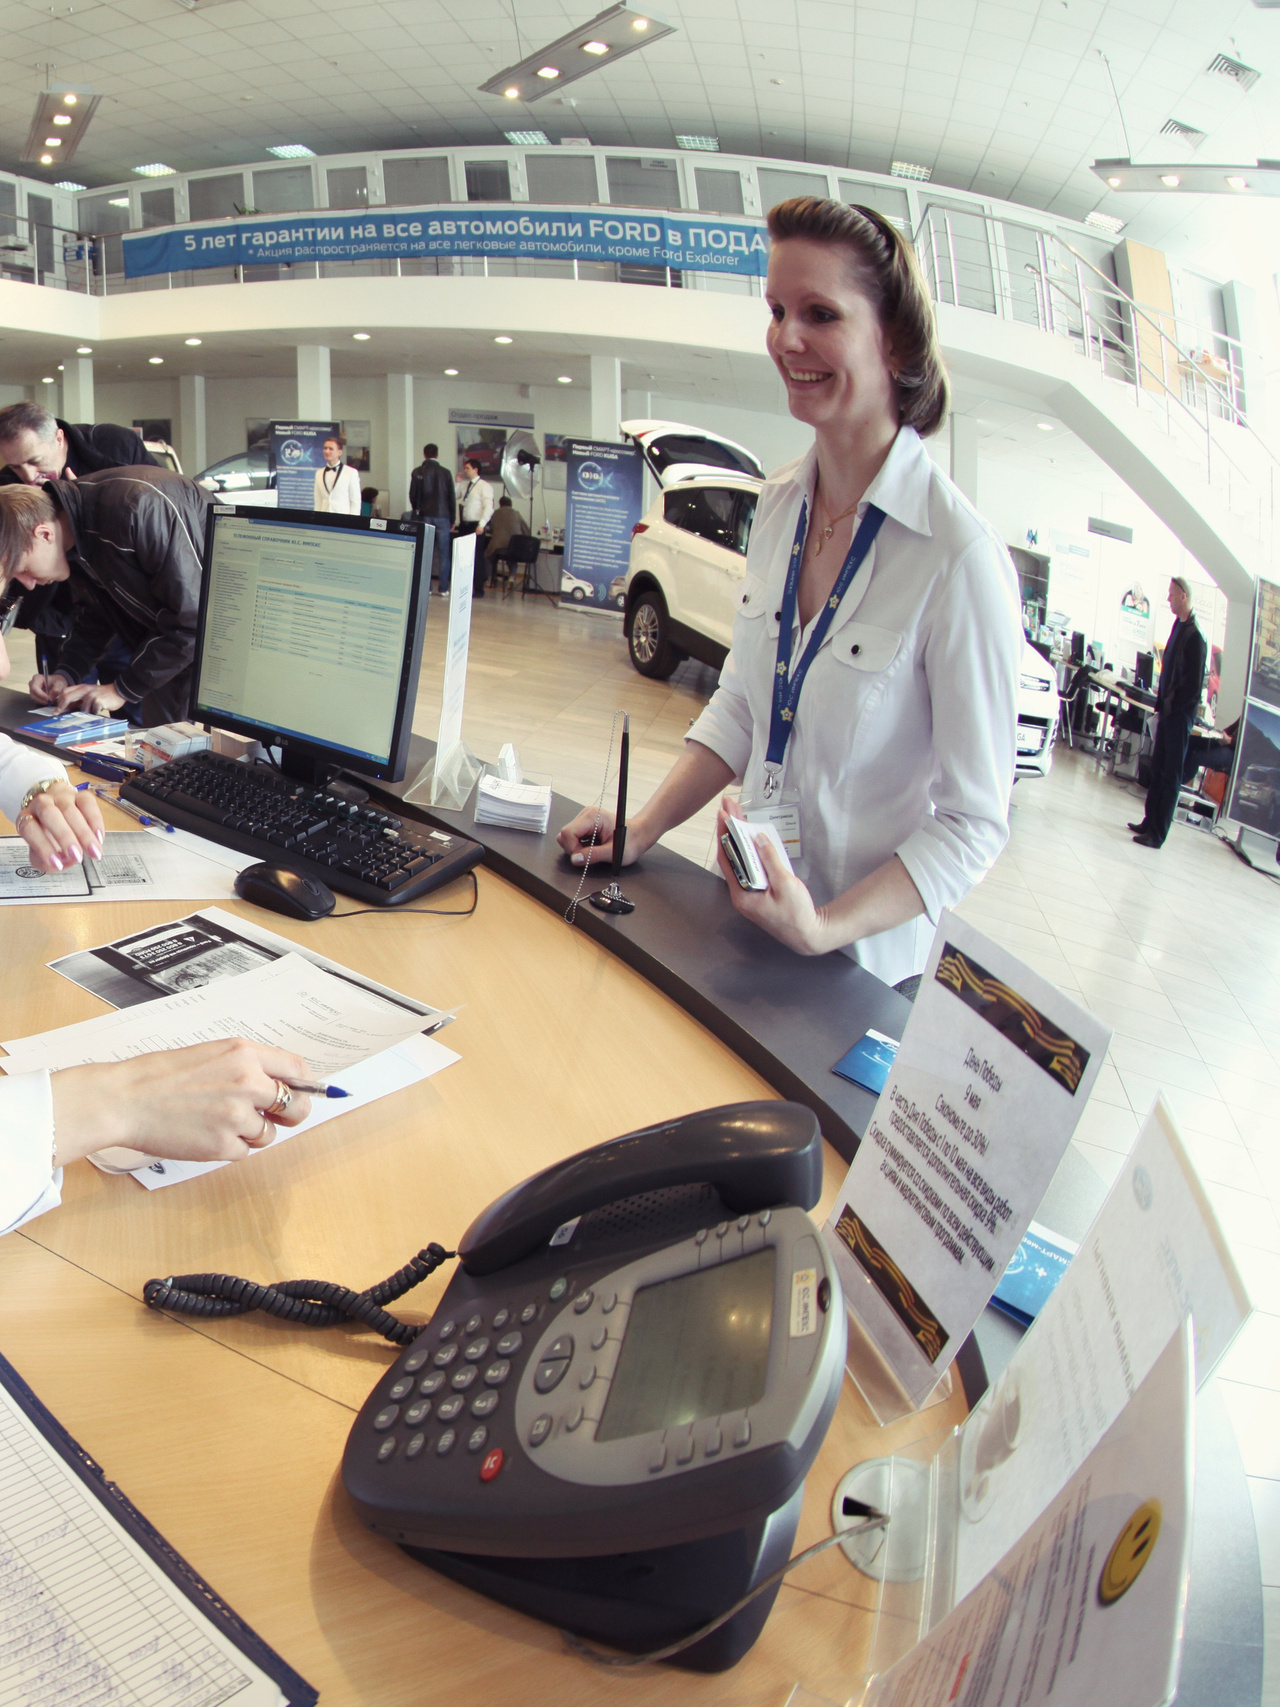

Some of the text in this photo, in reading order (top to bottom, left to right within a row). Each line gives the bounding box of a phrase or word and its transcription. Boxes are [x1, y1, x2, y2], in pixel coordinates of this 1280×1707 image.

[184, 235, 196, 251] 5
[201, 234, 236, 250] лет
[241, 226, 344, 247] гарантии
[350, 223, 377, 239] на
[382, 221, 422, 237] все
[428, 216, 582, 238] автомобили
[589, 218, 661, 242] FORD
[667, 227, 682, 245] в
[256, 239, 739, 267] Акция распространяется на все легковые автомобили, кроме Ford Explorer
[963, 1047, 1003, 1093] День Победы
[964, 1084, 981, 1111] 9 мая
[889, 1085, 897, 1100] В
[895, 1090, 909, 1114] честь
[906, 1102, 920, 1123] Дня
[920, 1112, 937, 1144] Победы
[943, 1143, 952, 1159] по
[949, 1145, 959, 1163] 10
[955, 1157, 968, 1175] мая
[965, 1168, 974, 1181] на
[970, 1171, 982, 1191] все
[979, 1181, 995, 1205] виды
[993, 1197, 1012, 1223] работ
[935, 1093, 990, 1156] Сэкономьте до 30%!
[869, 1120, 995, 1272] Скидка суммируется со скидками по всем действующим
[879, 1159, 898, 1187] акциям
[899, 1181, 936, 1229] маркетинговым
[889, 1111, 931, 1159] предоставляется
[926, 1152, 971, 1200] дополнительная
[968, 1194, 988, 1223] скидка
